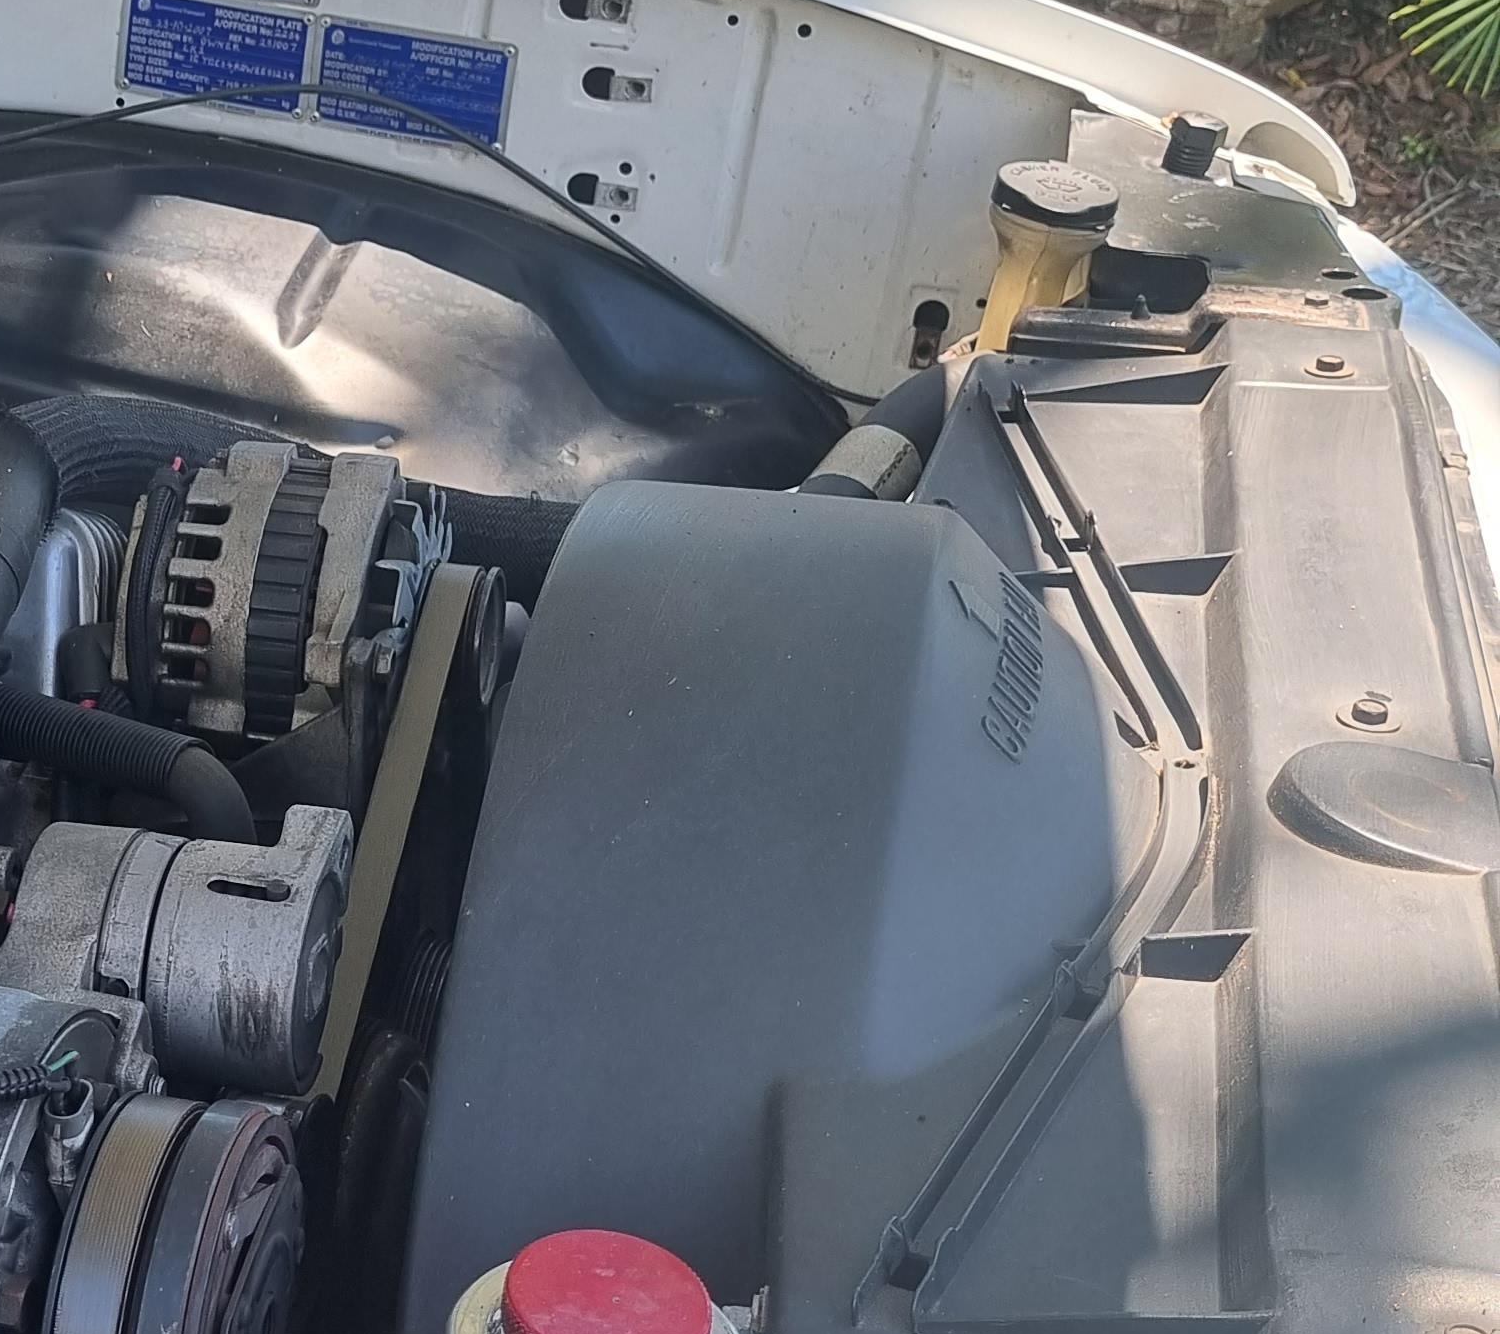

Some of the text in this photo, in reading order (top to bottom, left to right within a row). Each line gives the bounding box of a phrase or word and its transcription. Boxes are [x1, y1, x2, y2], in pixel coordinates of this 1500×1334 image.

[213, 18, 257, 33] A/OFFICER
[214, 7, 303, 31] MODIFICATION PLATE
[410, 50, 455, 67] A/OFFICER
[411, 40, 502, 64] MODIFICATION PLATE
[323, 58, 375, 75] MODIFICATION
[980, 618, 1044, 766] CAUTION
